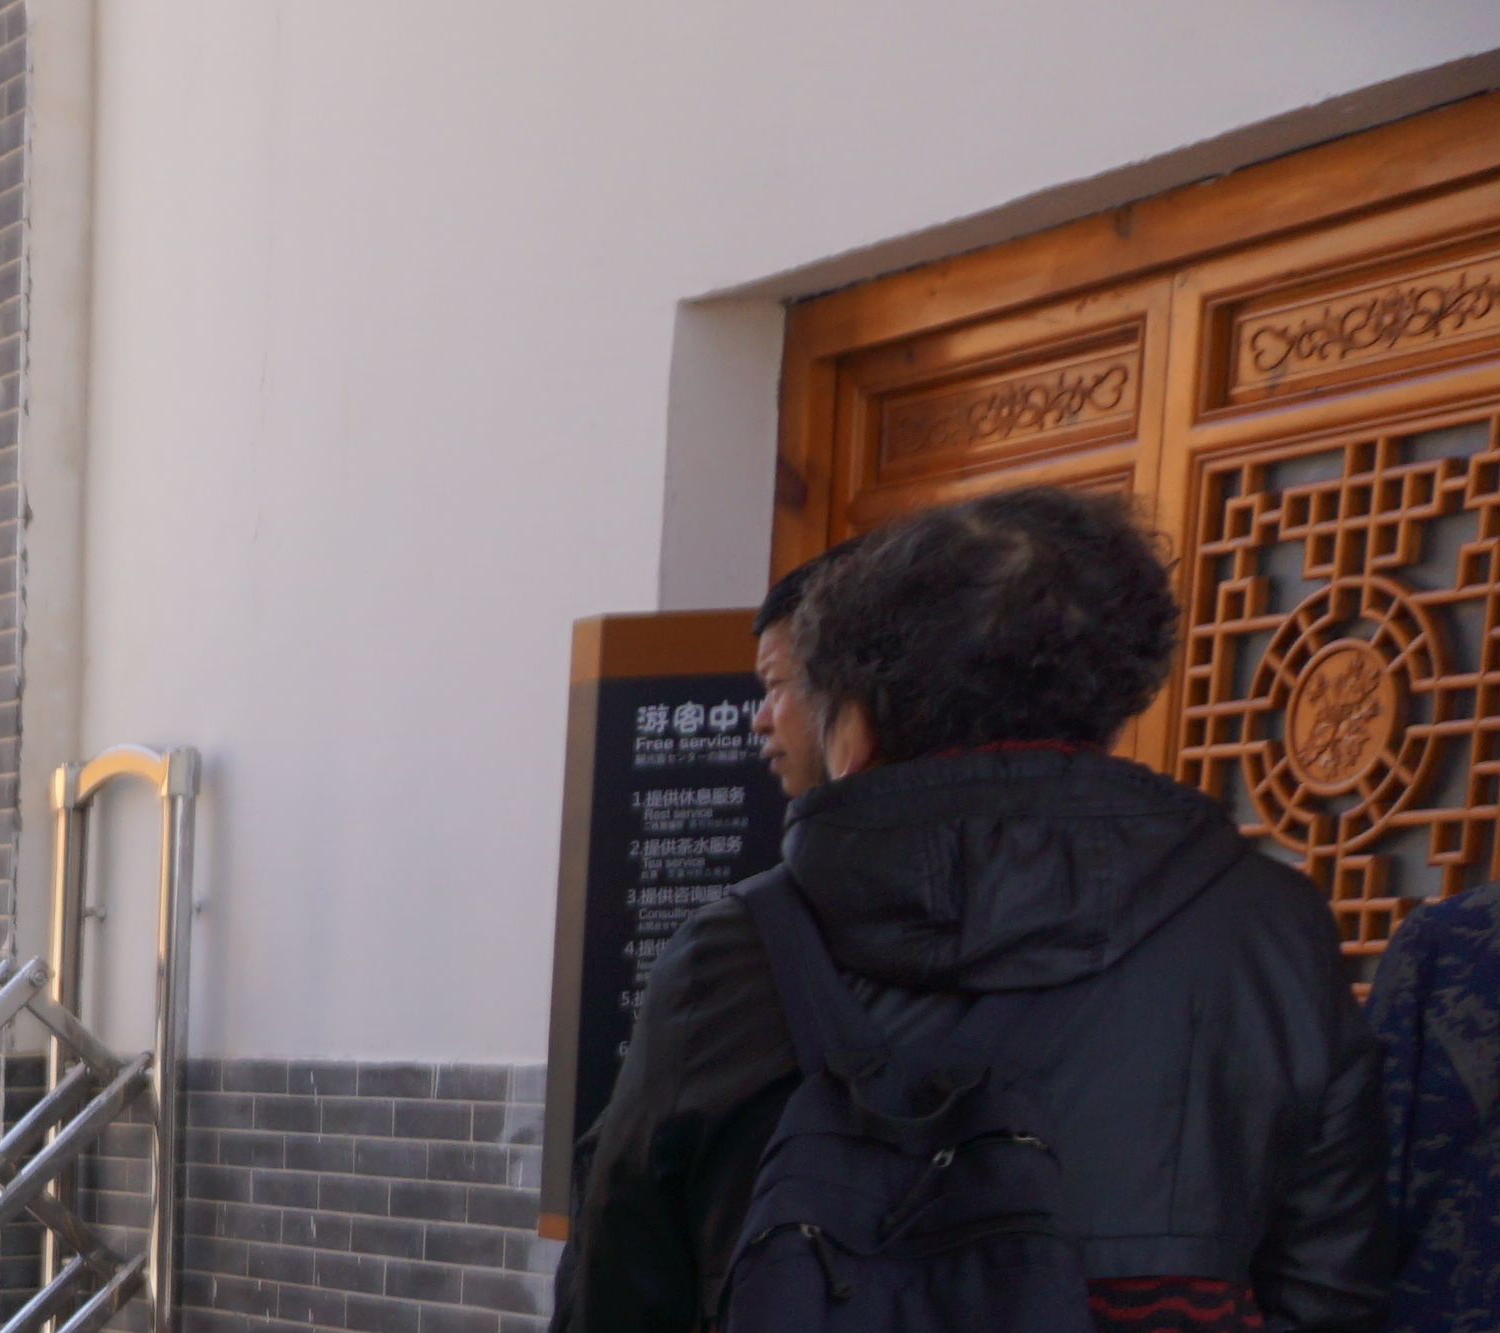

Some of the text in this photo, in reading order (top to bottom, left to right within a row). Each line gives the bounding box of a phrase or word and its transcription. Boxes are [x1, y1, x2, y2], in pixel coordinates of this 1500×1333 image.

[636, 699, 764, 734] 游客中
[635, 736, 674, 751] Free
[679, 734, 743, 750] service
